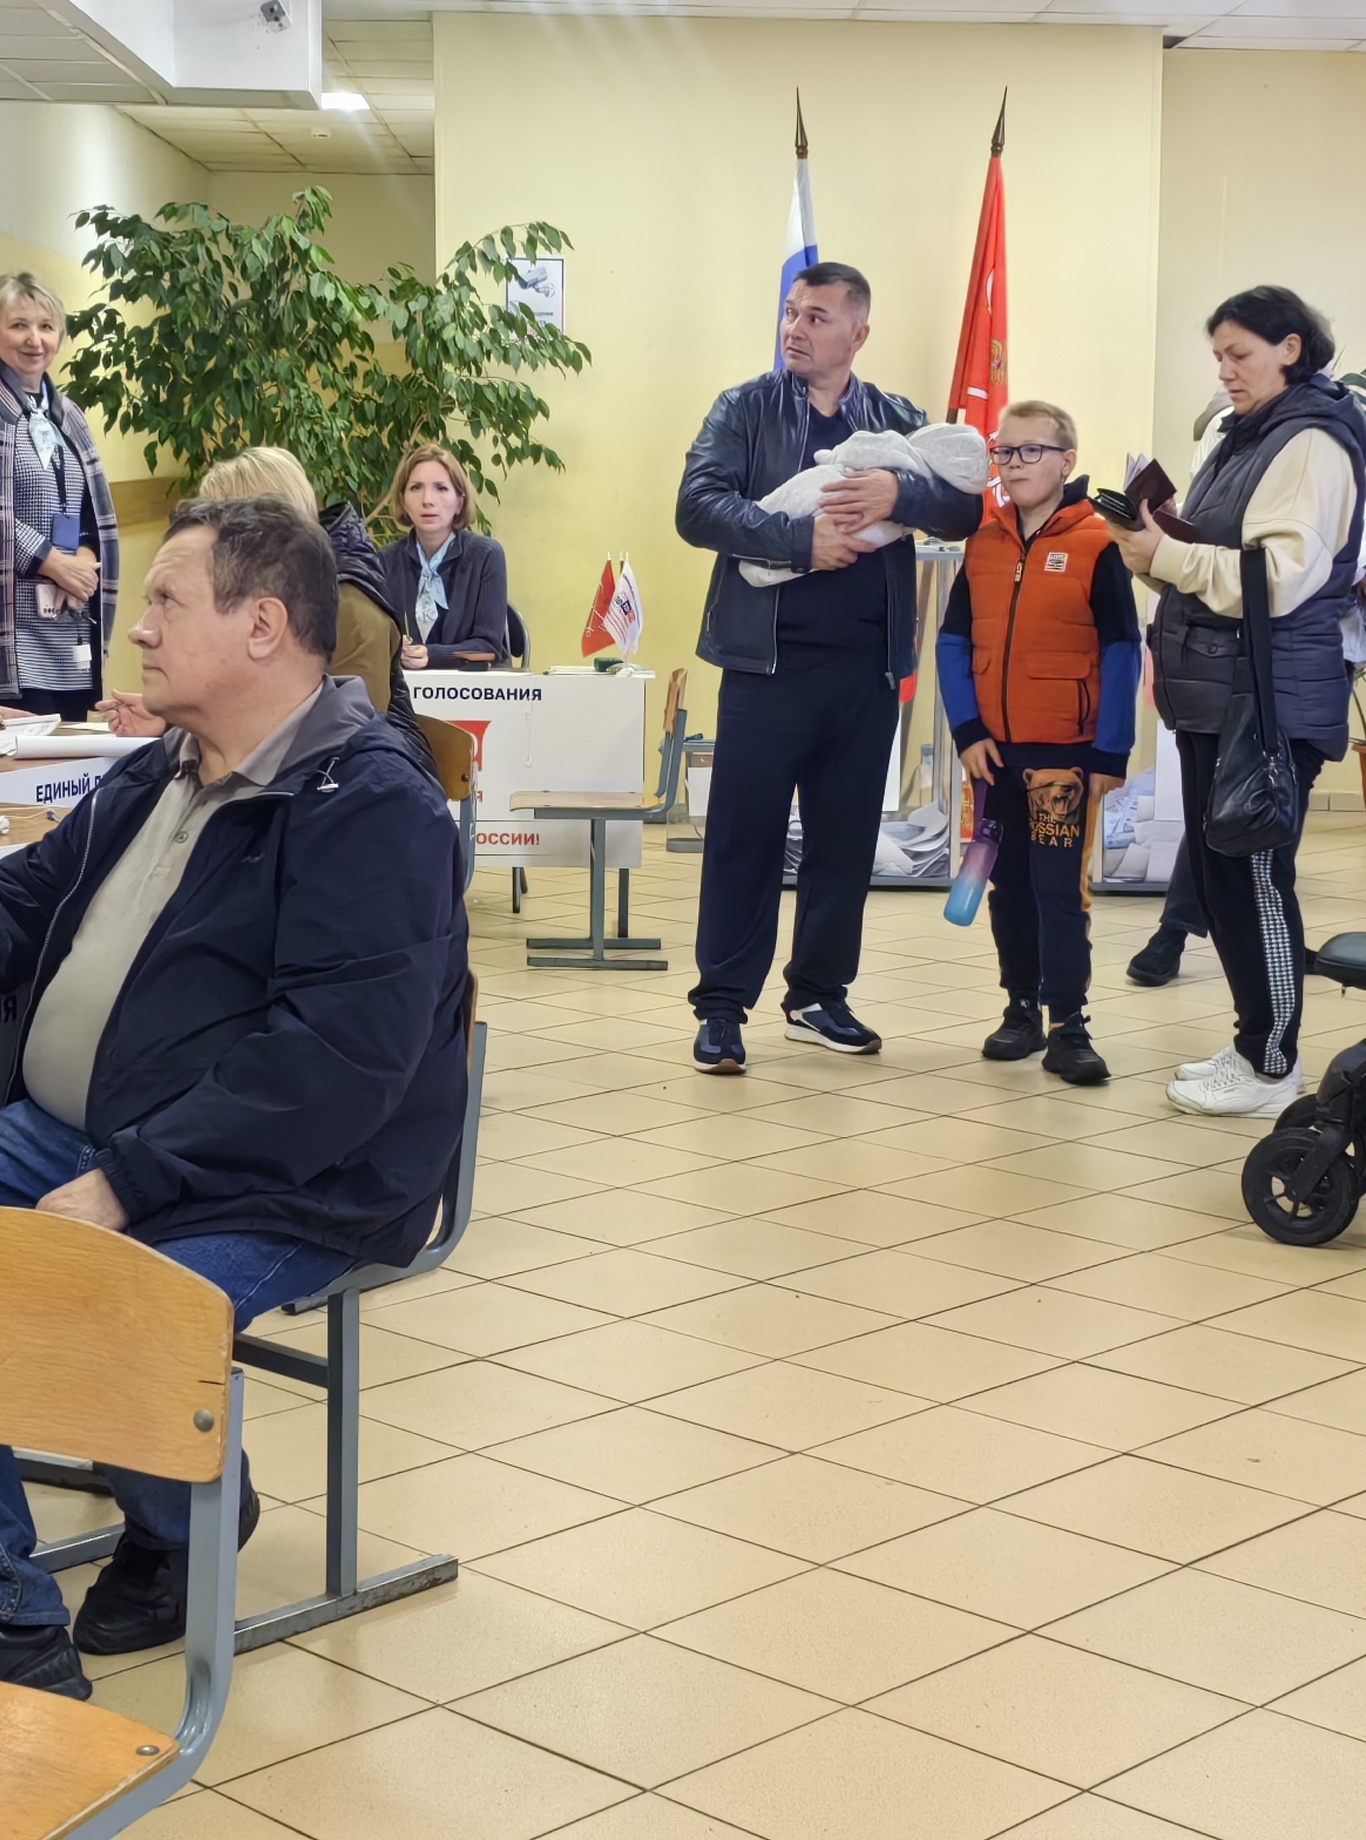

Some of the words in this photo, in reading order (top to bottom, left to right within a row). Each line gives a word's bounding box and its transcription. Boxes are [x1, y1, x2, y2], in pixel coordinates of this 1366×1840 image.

[413, 686, 542, 702] ГОЛОСОВАНИЯ
[35, 772, 91, 804] ЕДИНЫЙ
[1030, 820, 1080, 838] SSIAN
[476, 832, 540, 846] ОССИИ!
